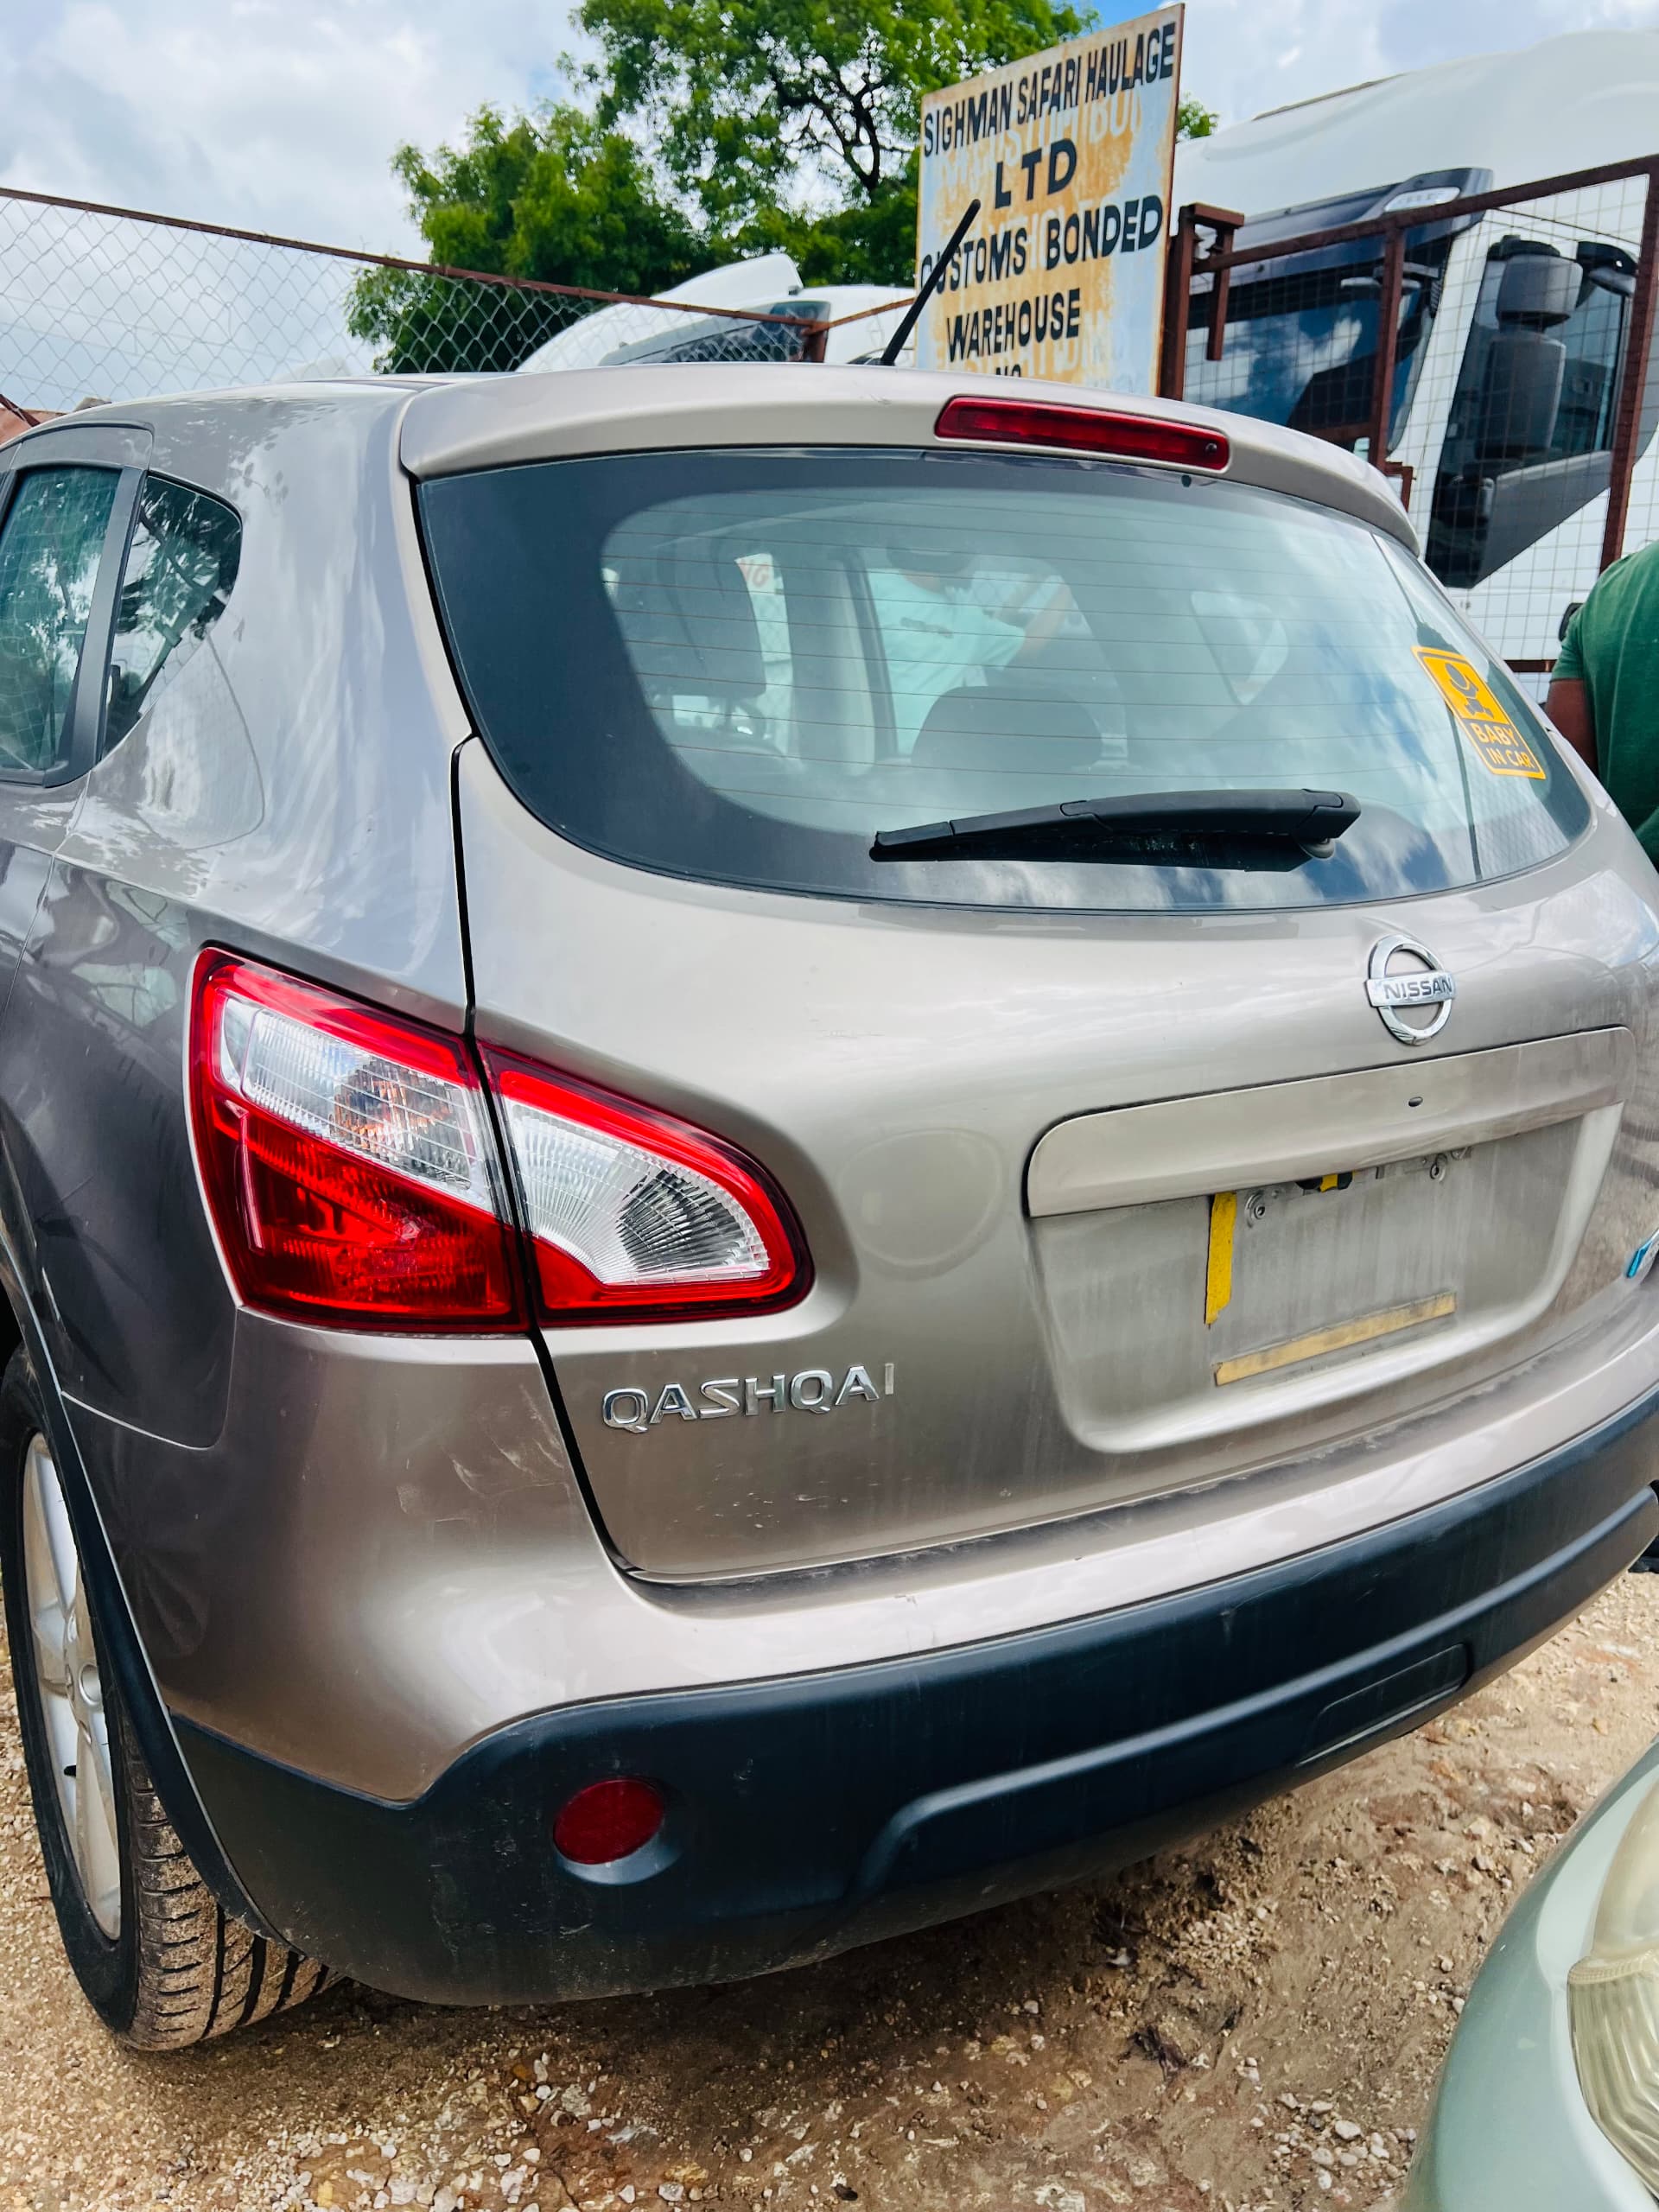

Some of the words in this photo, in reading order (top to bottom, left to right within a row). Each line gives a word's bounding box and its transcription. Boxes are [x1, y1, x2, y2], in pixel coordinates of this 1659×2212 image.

[924, 81, 1013, 157] SIGHMAN
[1017, 55, 1081, 125] SAFARI
[1086, 22, 1176, 104] HAULAGE
[995, 138, 1077, 209] LTD
[1046, 194, 1163, 270] BONDED
[947, 288, 1080, 363] WAREHOUSE
[1470, 722, 1519, 747] BABY
[1485, 747, 1508, 766] IN
[1506, 749, 1535, 769] CAR
[1383, 976, 1452, 1000] NISSAN
[601, 1362, 895, 1434] QASHQAI
